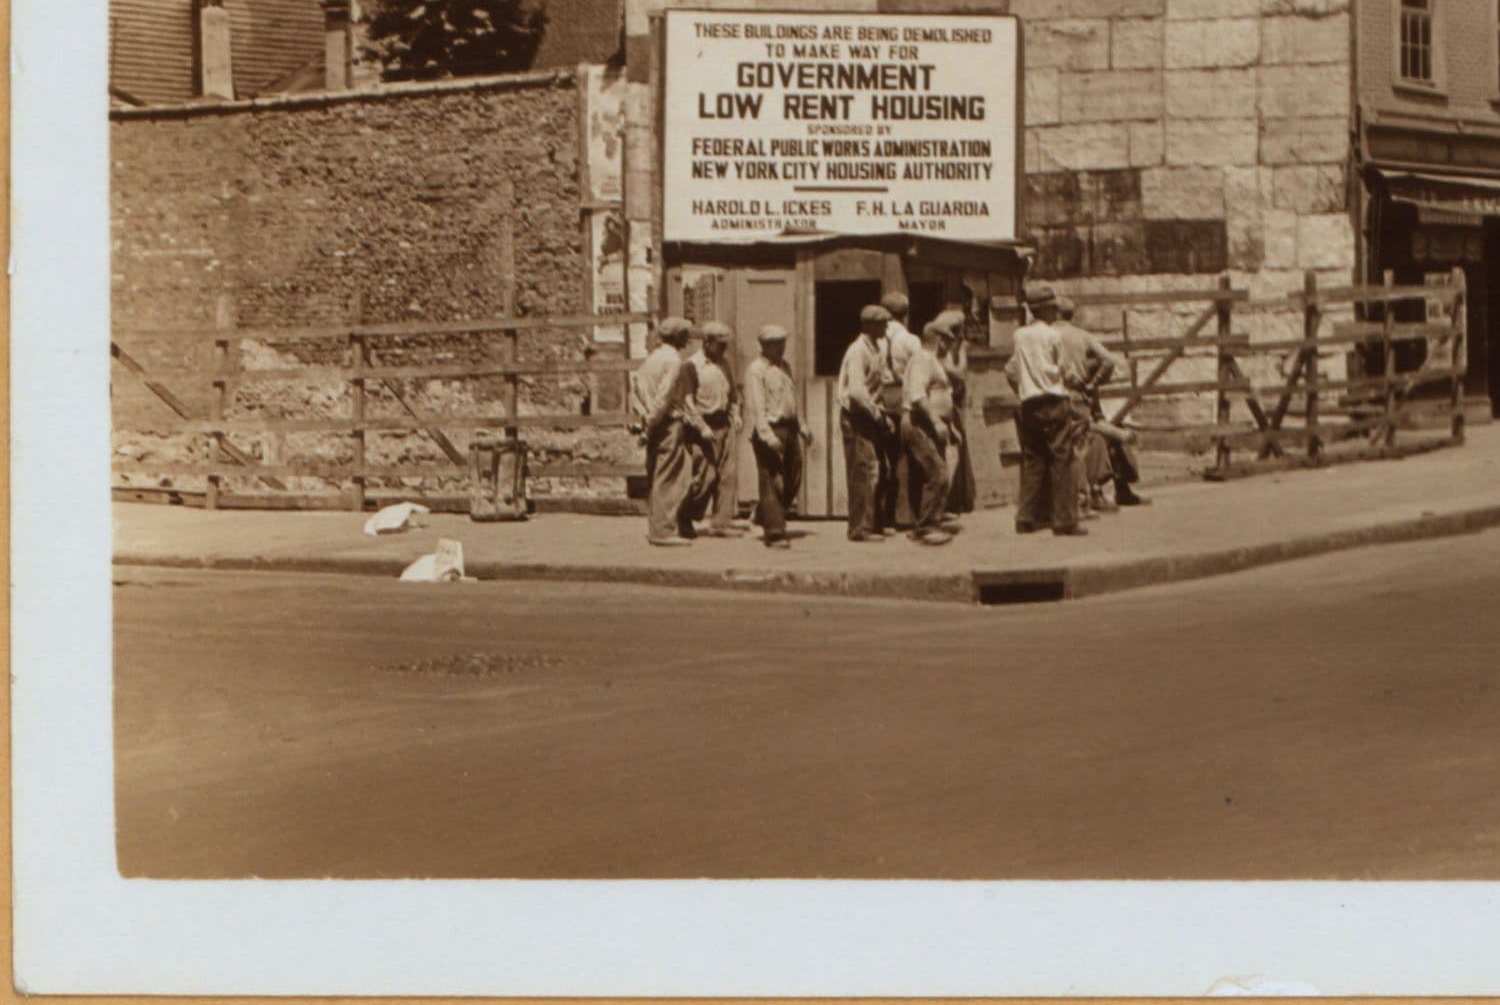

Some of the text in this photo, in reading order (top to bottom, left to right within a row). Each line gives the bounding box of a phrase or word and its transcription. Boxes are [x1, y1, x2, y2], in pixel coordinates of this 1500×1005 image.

[694, 22, 992, 43] THESE BUILDINGS ARE BEING DEMOLISHED
[766, 43, 919, 60] TO MAKE WAY FOR
[737, 62, 935, 91] GOVERNMENT
[698, 92, 985, 120] LOW RENT HOUSING
[807, 123, 892, 136] SPONSORED BY
[692, 138, 992, 157] FEDERAL PUBLIC WORKS ADMINISTRATION
[692, 161, 993, 180] NEW YORK CITY HOUSING AUTHORITY
[692, 199, 832, 215] HAROLD L. ICKES
[891, 201, 914, 216] LA
[919, 201, 990, 216] GUARDIA
[711, 218, 816, 230] ADMINISTRATOR
[898, 219, 946, 231] MAYOR
